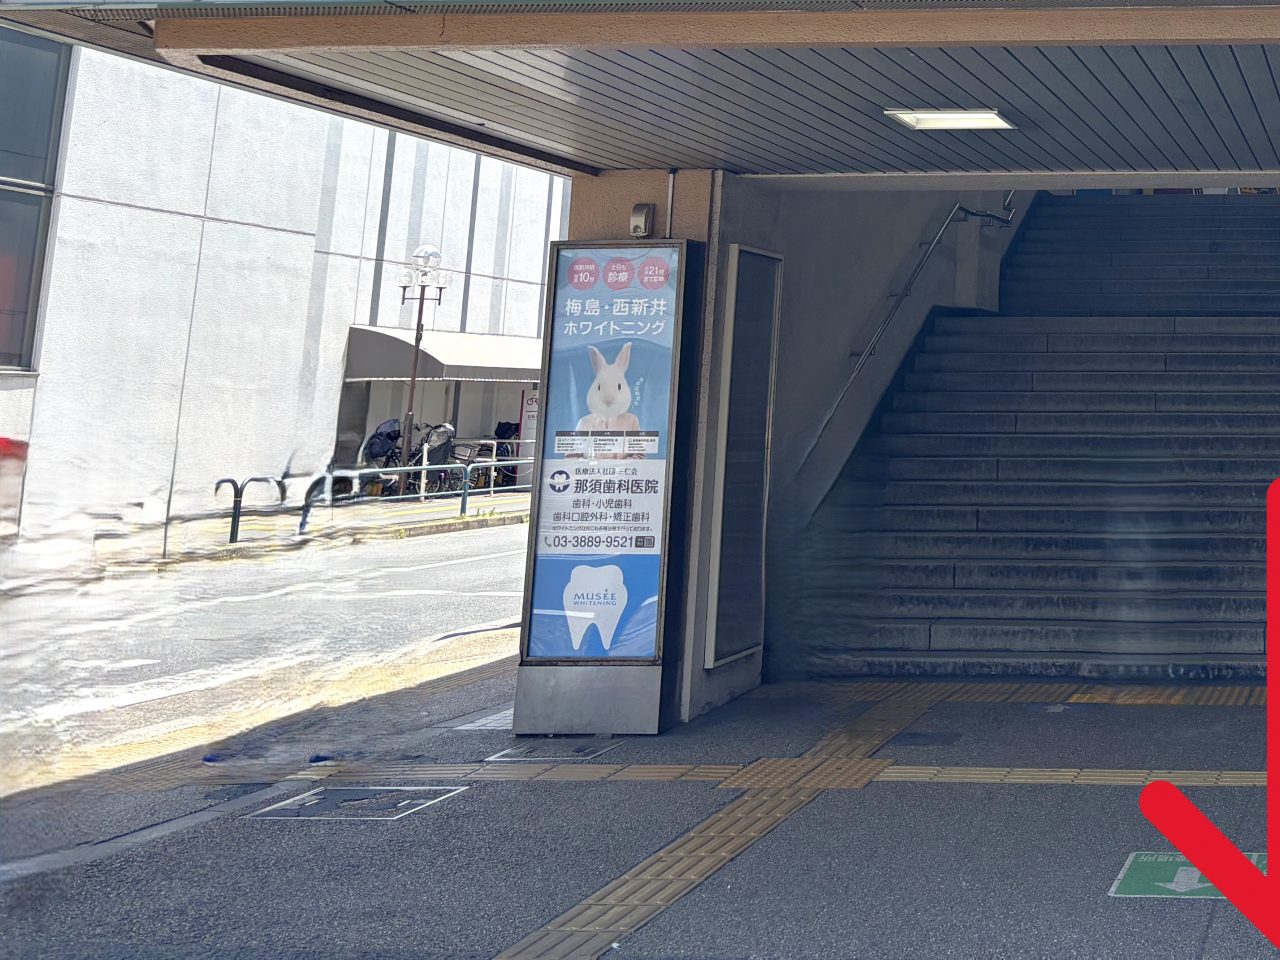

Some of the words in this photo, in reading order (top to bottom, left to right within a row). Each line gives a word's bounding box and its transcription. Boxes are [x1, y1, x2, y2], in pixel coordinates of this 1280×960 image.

[565, 298, 668, 317] 梅島・西新井
[563, 320, 666, 336] ホワイトニング
[573, 479, 660, 494] 那須歯科医院
[572, 499, 633, 509] 歯科・小児歯科
[552, 511, 650, 522] 歯科口腔外科・矯正歯科
[553, 536, 634, 548] 03-3889-9521
